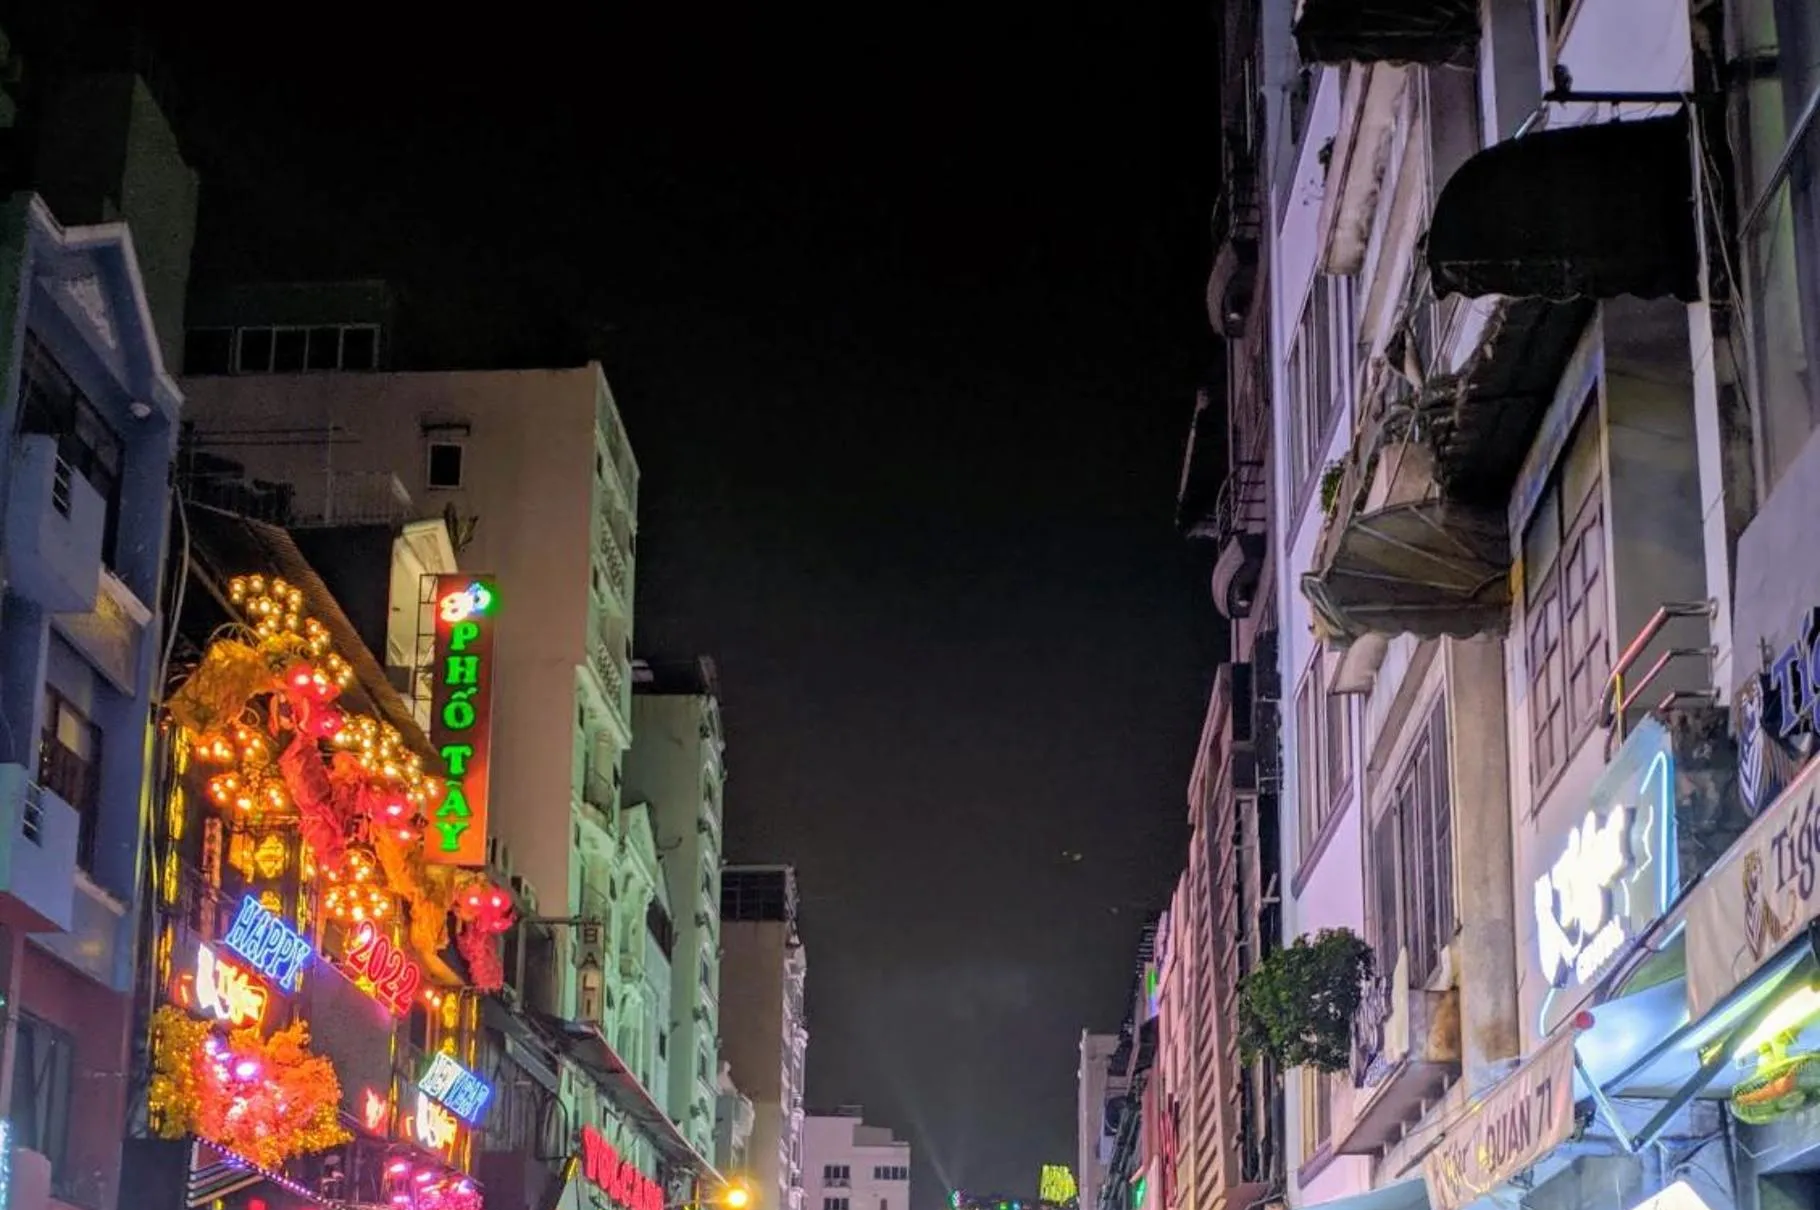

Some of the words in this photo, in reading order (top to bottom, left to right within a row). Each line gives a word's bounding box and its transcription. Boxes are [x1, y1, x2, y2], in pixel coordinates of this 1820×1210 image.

[442, 621, 479, 730] PHỐ
[225, 894, 311, 990] HAPPY
[349, 918, 420, 1016] 2022
[1536, 1076, 1552, 1139] 71
